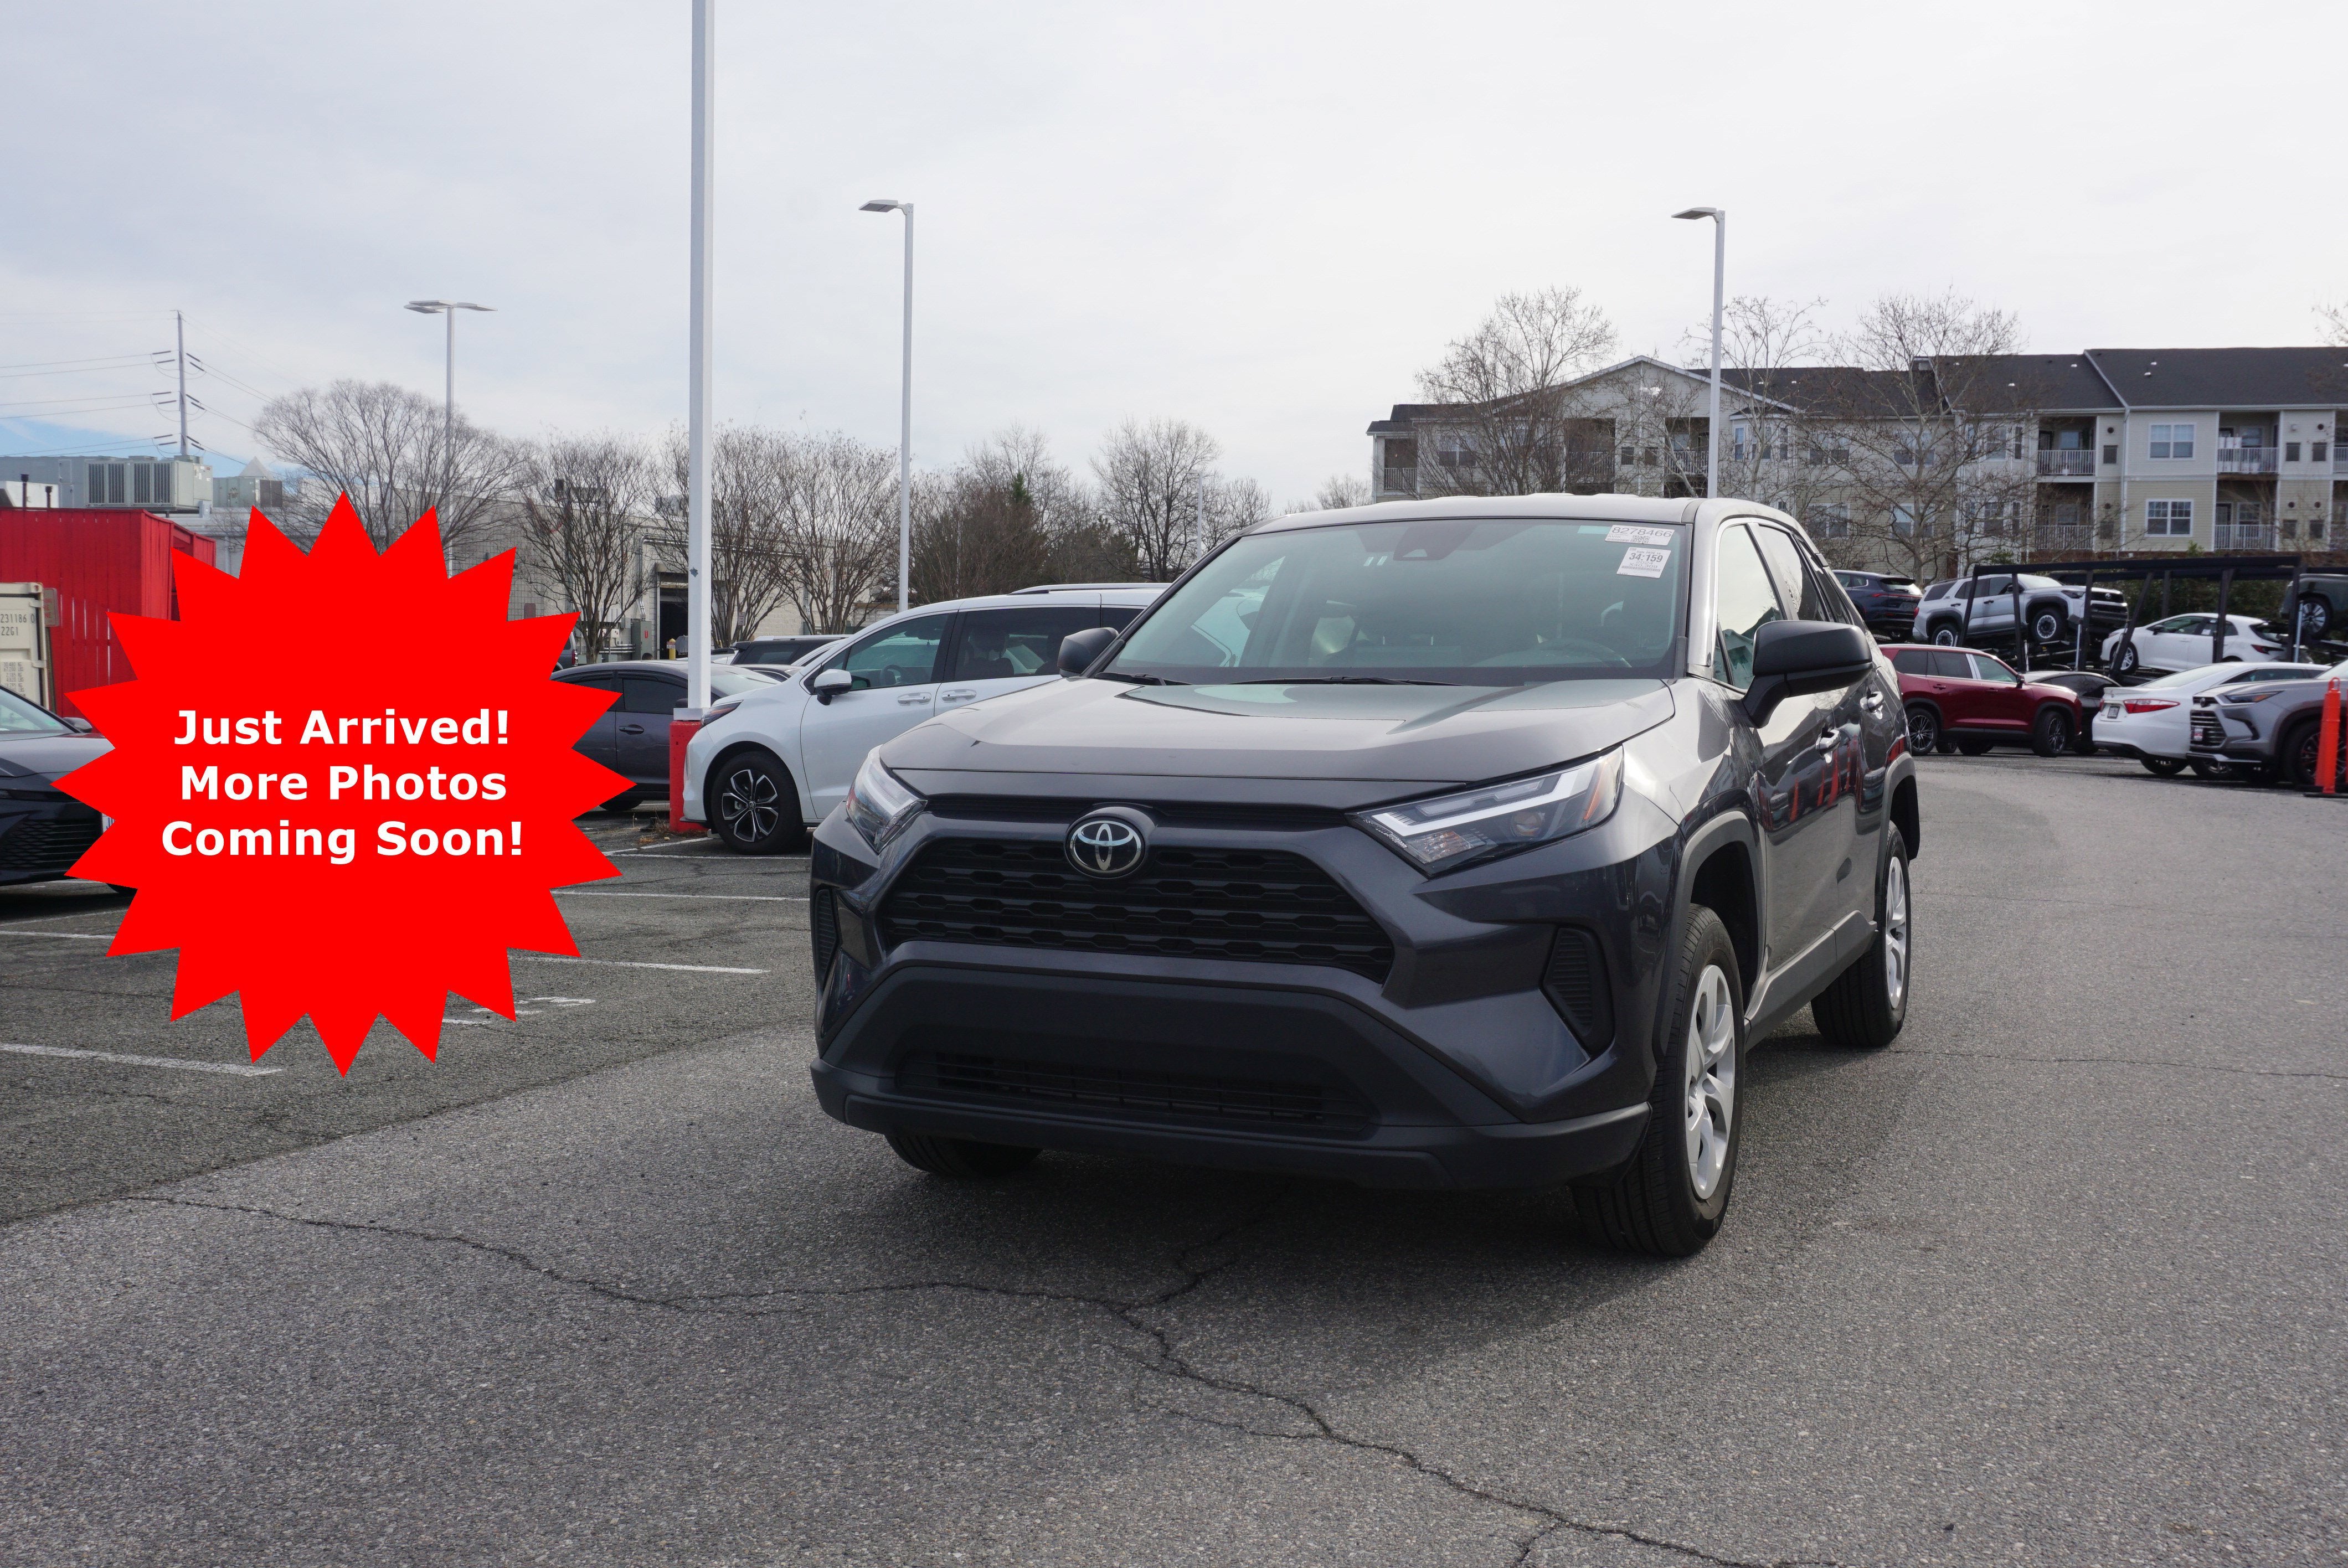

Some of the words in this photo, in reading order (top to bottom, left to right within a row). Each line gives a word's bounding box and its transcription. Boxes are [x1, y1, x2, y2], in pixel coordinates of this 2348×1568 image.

[1611, 527, 1672, 538] 8278466
[1629, 553, 1663, 563] 34:159
[1, 613, 27, 623] 231186
[1, 626, 19, 636] 22G1
